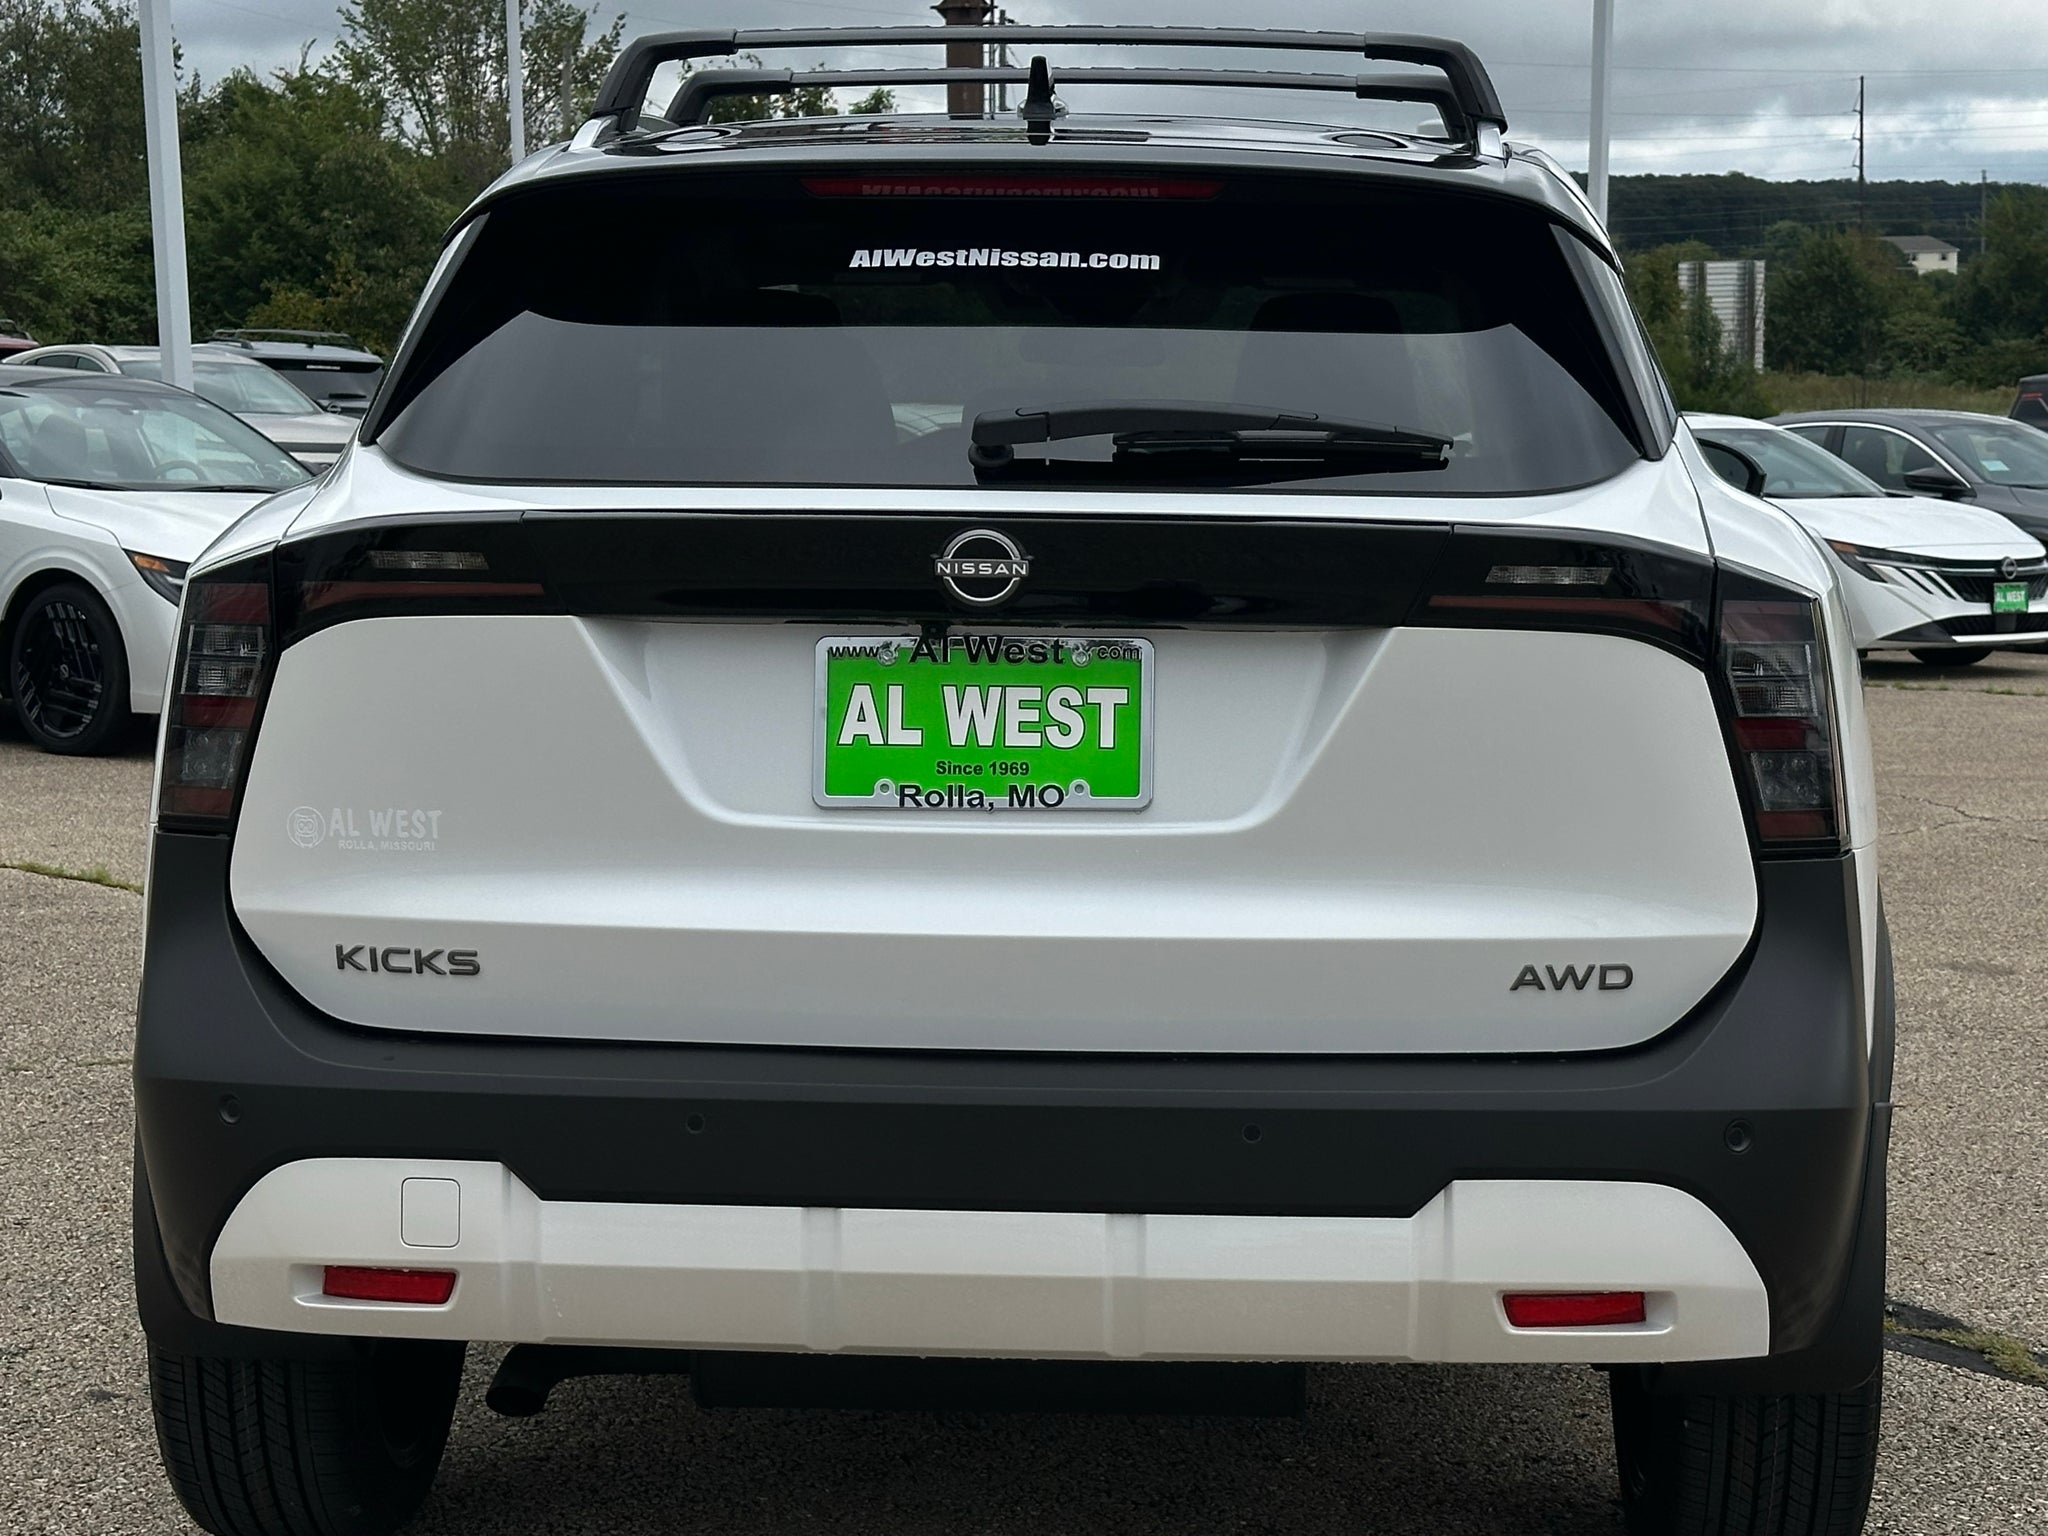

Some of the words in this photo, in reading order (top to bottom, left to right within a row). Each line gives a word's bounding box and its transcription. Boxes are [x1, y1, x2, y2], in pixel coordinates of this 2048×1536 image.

[849, 248, 1161, 271] AlWestNissan.com
[937, 562, 1027, 575] NISSAN
[909, 634, 950, 664] Al
[962, 635, 1066, 664] West
[837, 683, 923, 746] AL
[941, 684, 1130, 749] WEST
[935, 760, 984, 776] Since
[988, 761, 1030, 776] 1969
[899, 784, 995, 812] Rolla,
[1008, 784, 1065, 808] MO
[329, 807, 361, 838] AL
[368, 808, 443, 840] WEST
[381, 840, 436, 851] MISSOURI
[335, 944, 481, 976] KICKS
[1509, 963, 1634, 991] AWD
